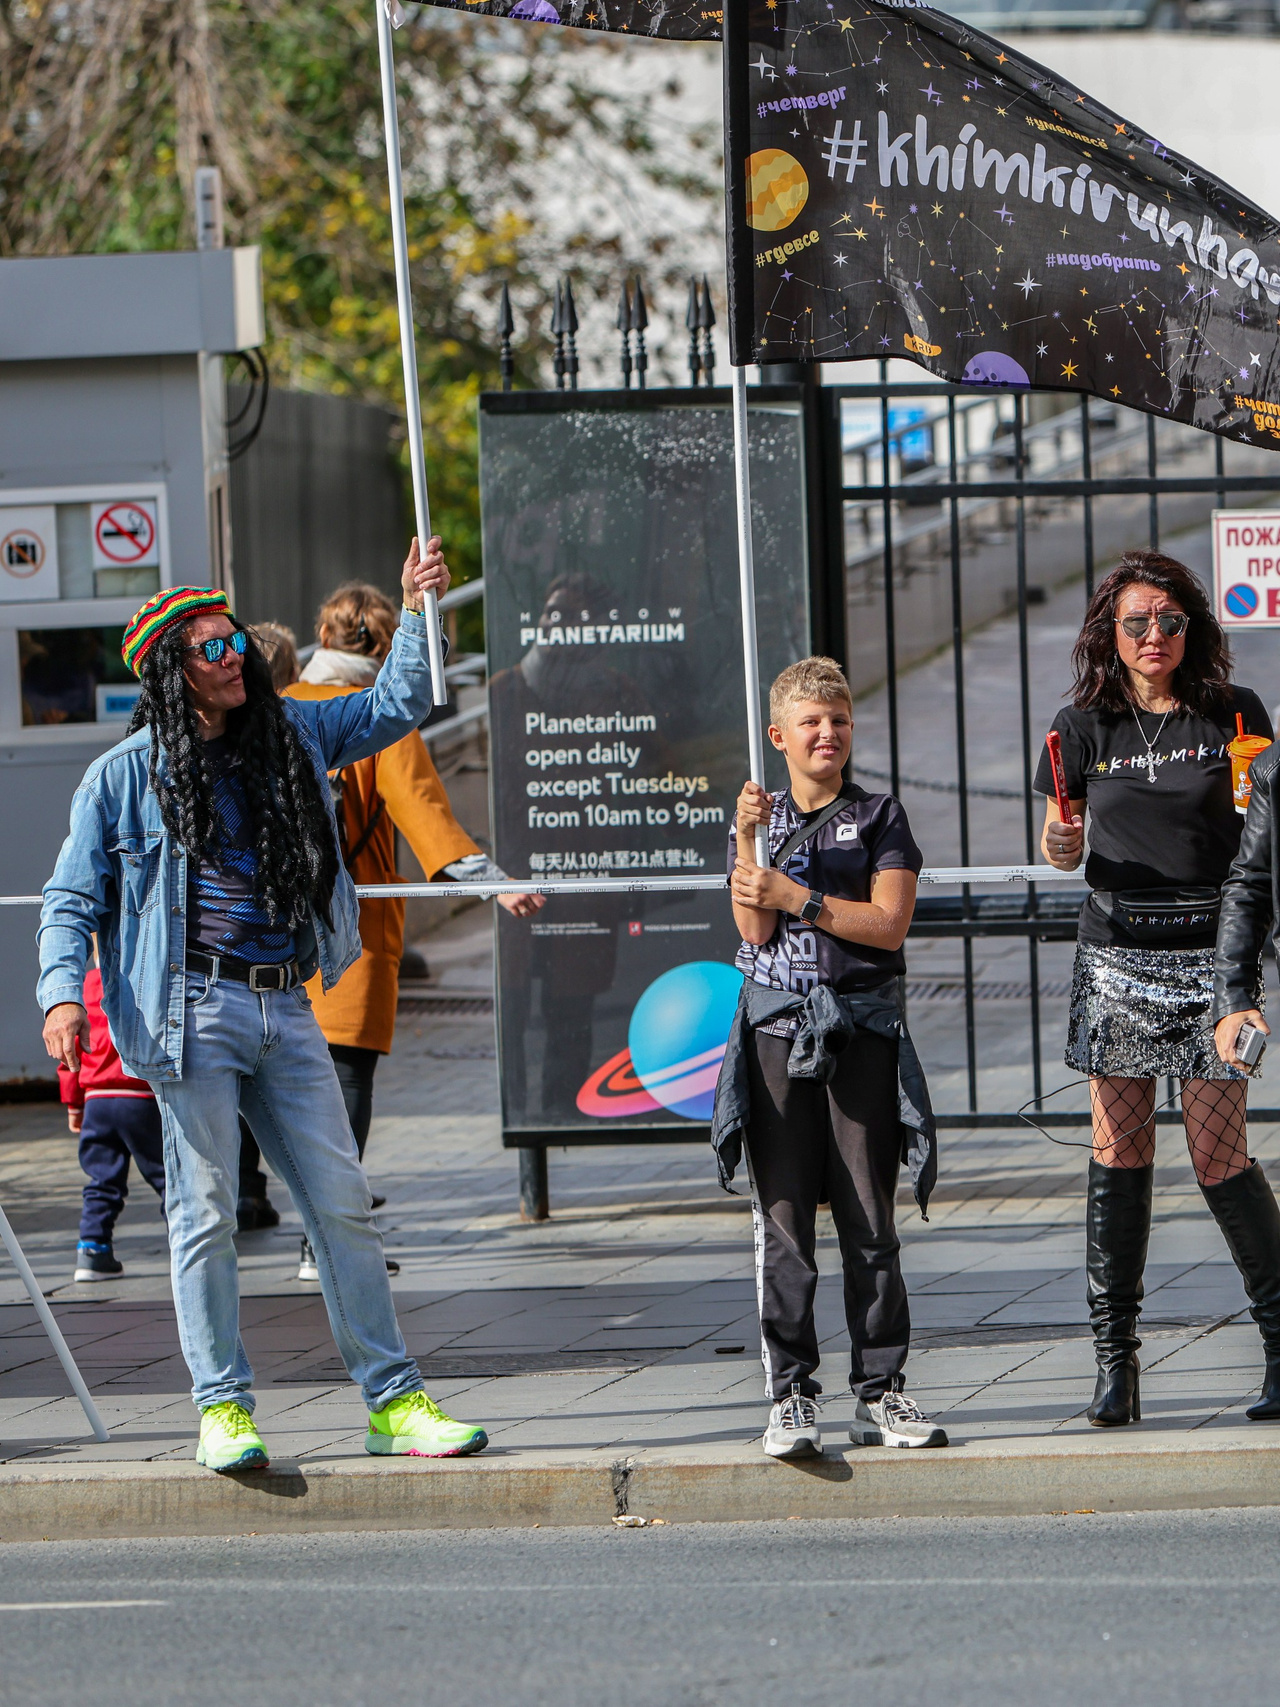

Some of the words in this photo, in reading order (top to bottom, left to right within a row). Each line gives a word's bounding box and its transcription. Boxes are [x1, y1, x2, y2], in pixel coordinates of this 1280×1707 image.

[756, 86, 848, 118] #четверг
[755, 229, 820, 268] #гдевсе
[1045, 252, 1161, 273] #надобрать
[520, 623, 685, 646] PLANETARIUM
[525, 711, 657, 735] Planetarium
[525, 748, 582, 770] open
[587, 741, 641, 768] daily
[526, 775, 602, 800] except
[605, 771, 709, 797] Tuesdays
[528, 806, 580, 828] from
[585, 804, 642, 826] 10am
[646, 806, 670, 825] to
[674, 802, 724, 828] 9pm
